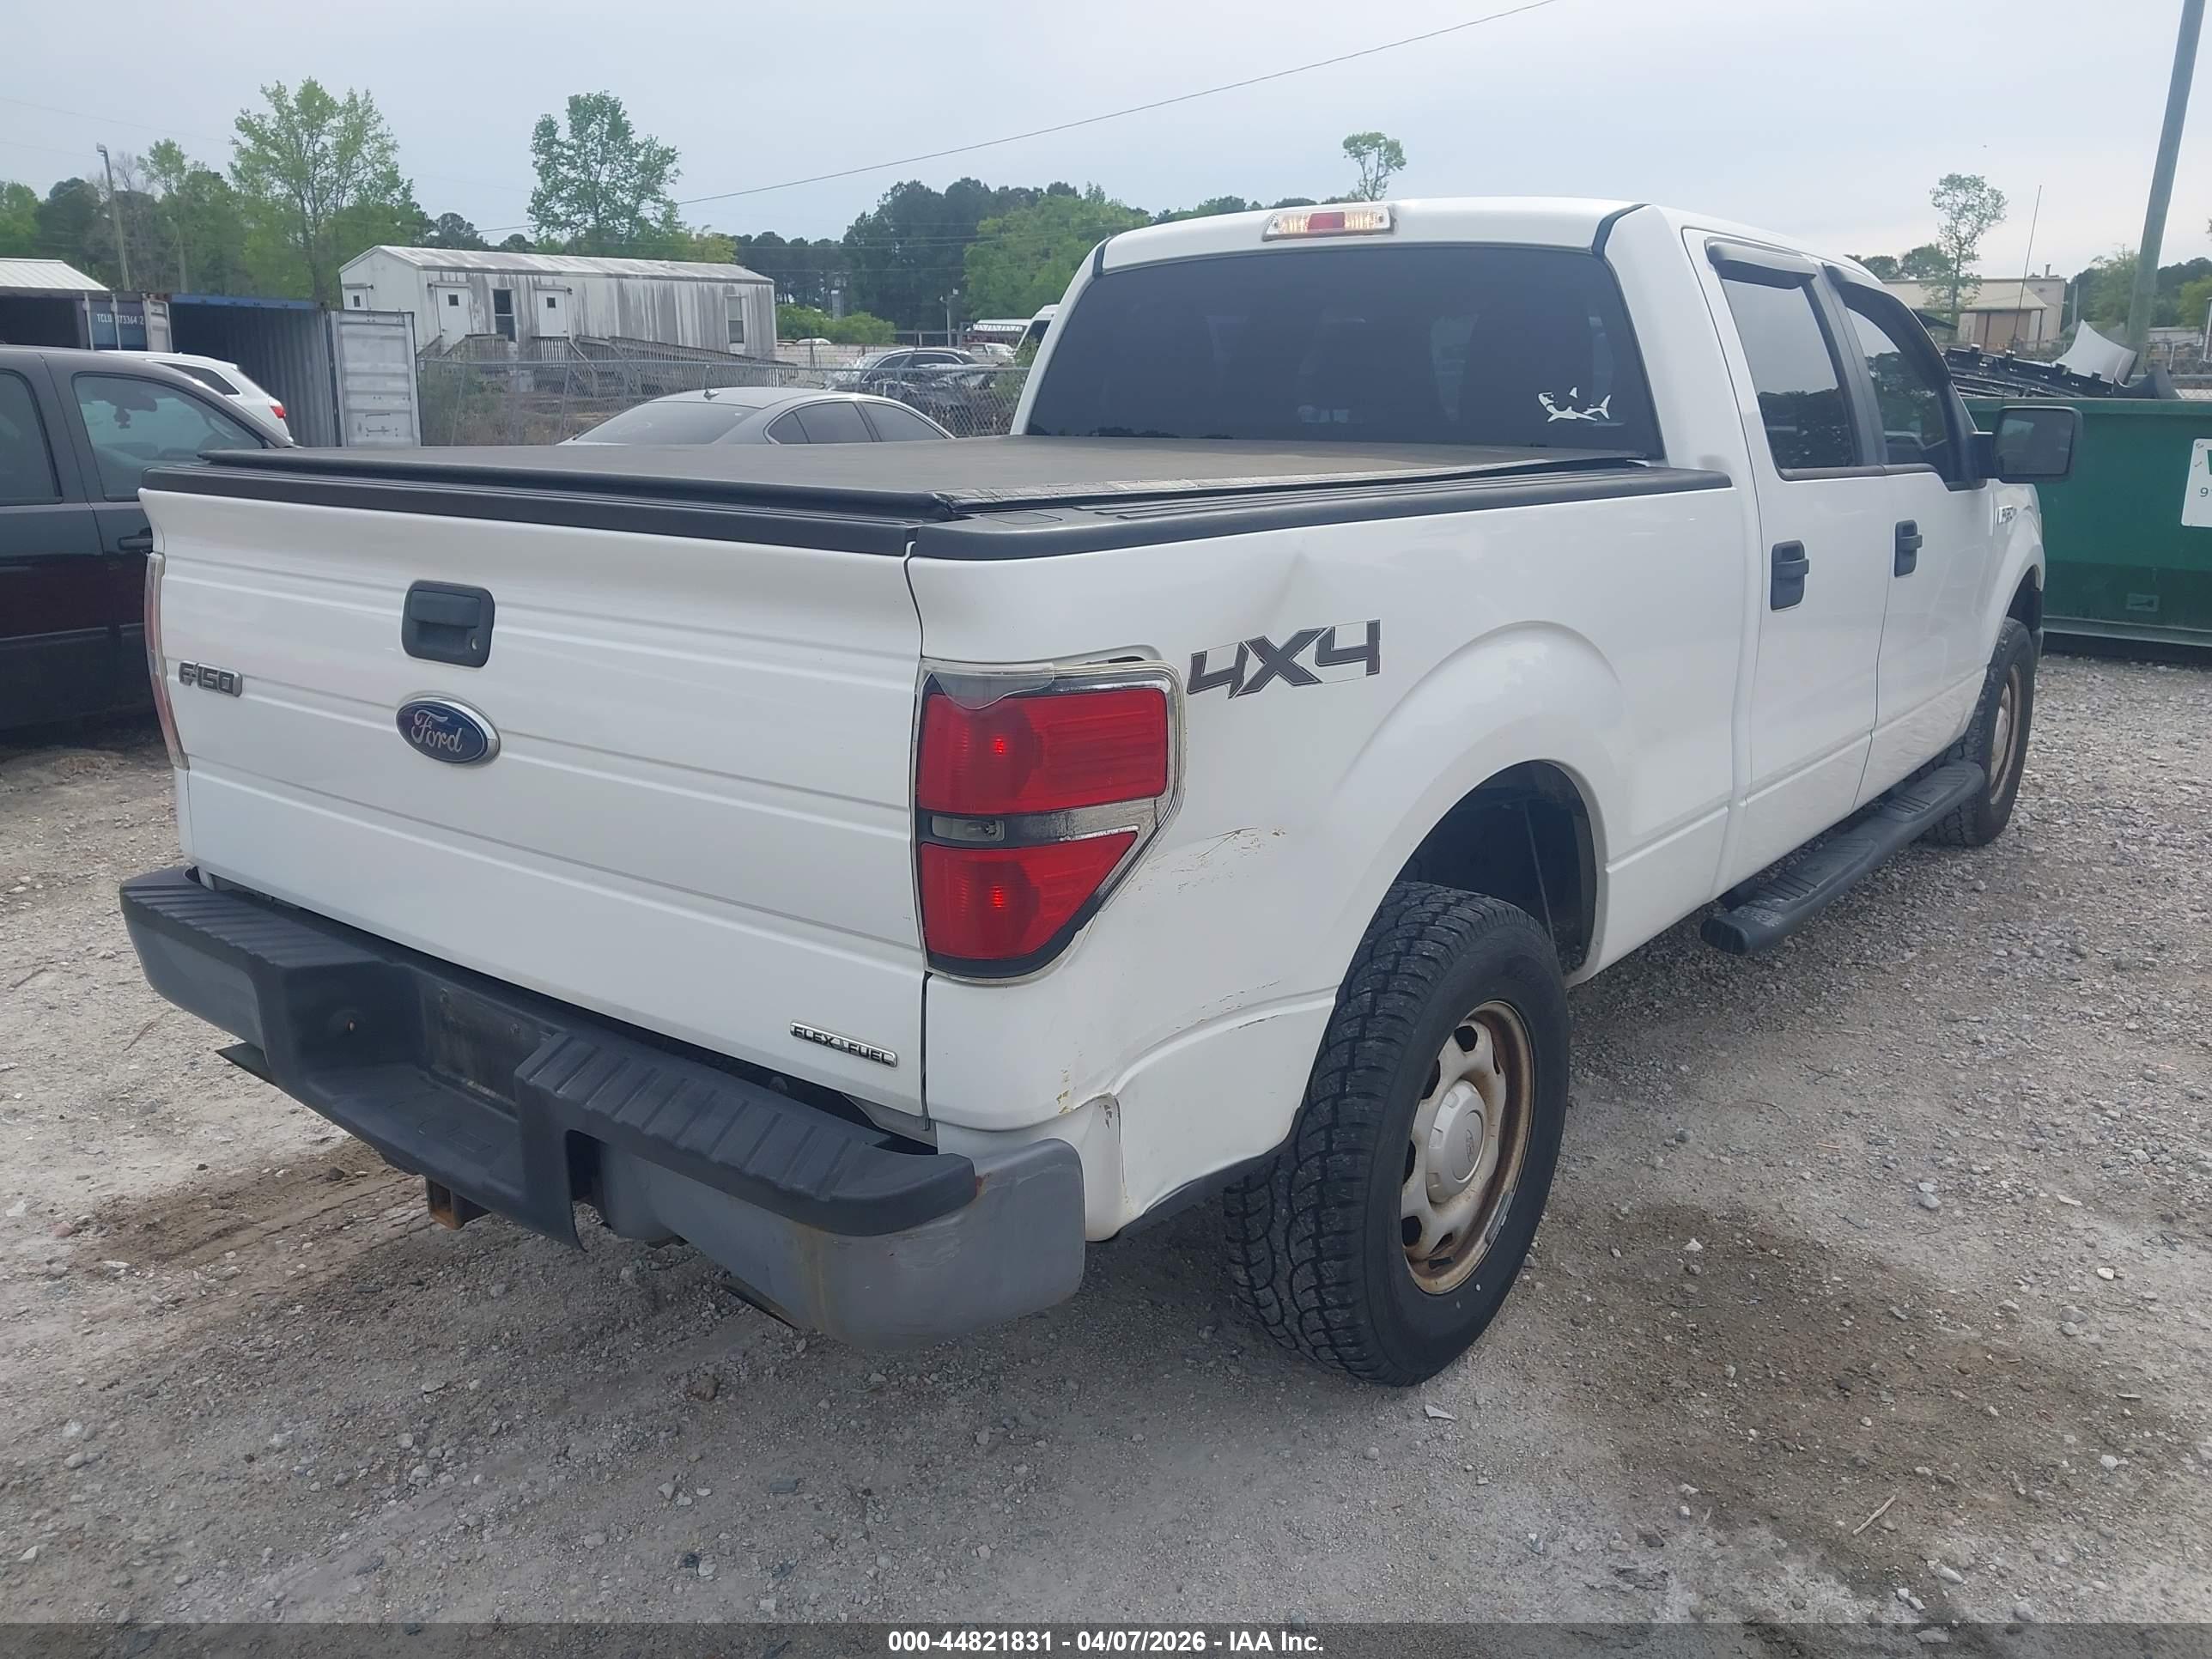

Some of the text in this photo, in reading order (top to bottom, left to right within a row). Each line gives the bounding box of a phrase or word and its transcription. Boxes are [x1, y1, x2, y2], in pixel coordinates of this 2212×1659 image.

[2200, 487, 2212, 497] 9
[179, 661, 234, 695] F-150
[411, 709, 463, 752] Ford
[793, 1025, 895, 1066] FLEX FUEL
